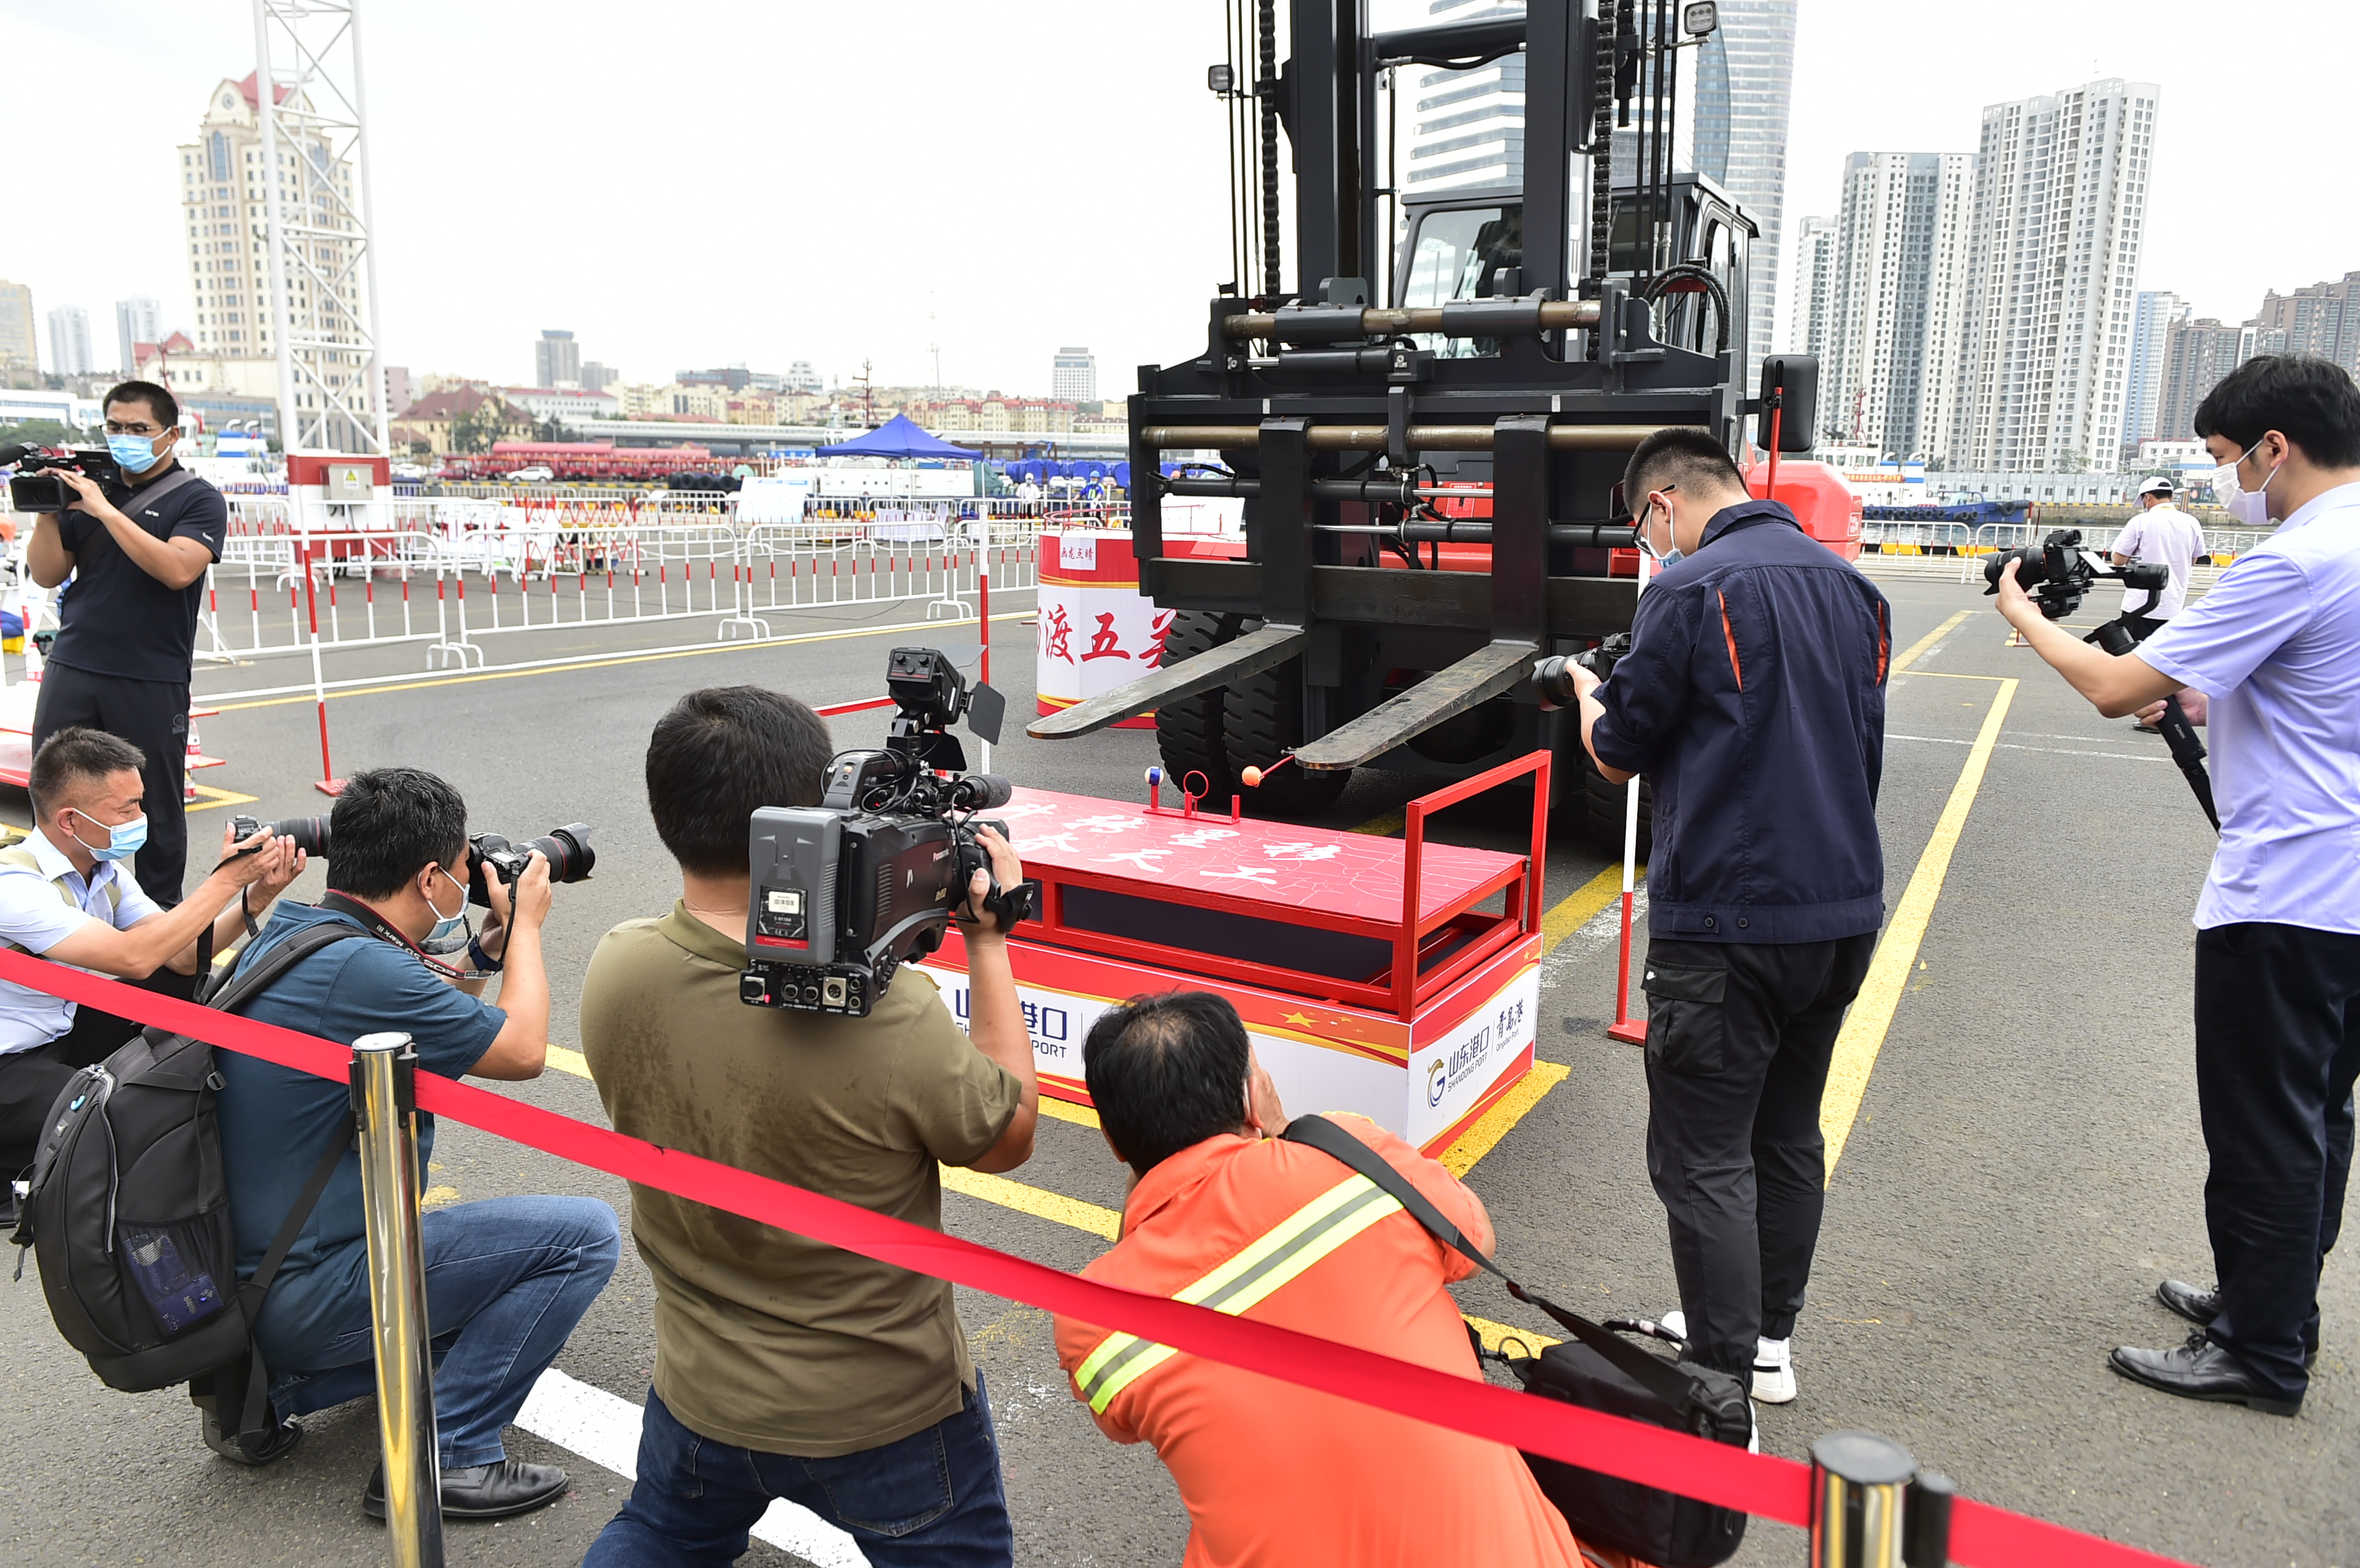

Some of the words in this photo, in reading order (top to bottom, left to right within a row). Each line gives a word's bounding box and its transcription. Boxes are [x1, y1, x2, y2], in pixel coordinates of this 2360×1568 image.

[1038, 603, 1177, 669] 渡五关
[383, 929, 404, 947] Mark
[955, 988, 1068, 1041] 山港口
[1031, 1039, 1068, 1059] PORT
[1447, 1064, 1476, 1093] SHANDONG
[1474, 1052, 1488, 1071] PORT
[1448, 1025, 1490, 1078] 山东港口
